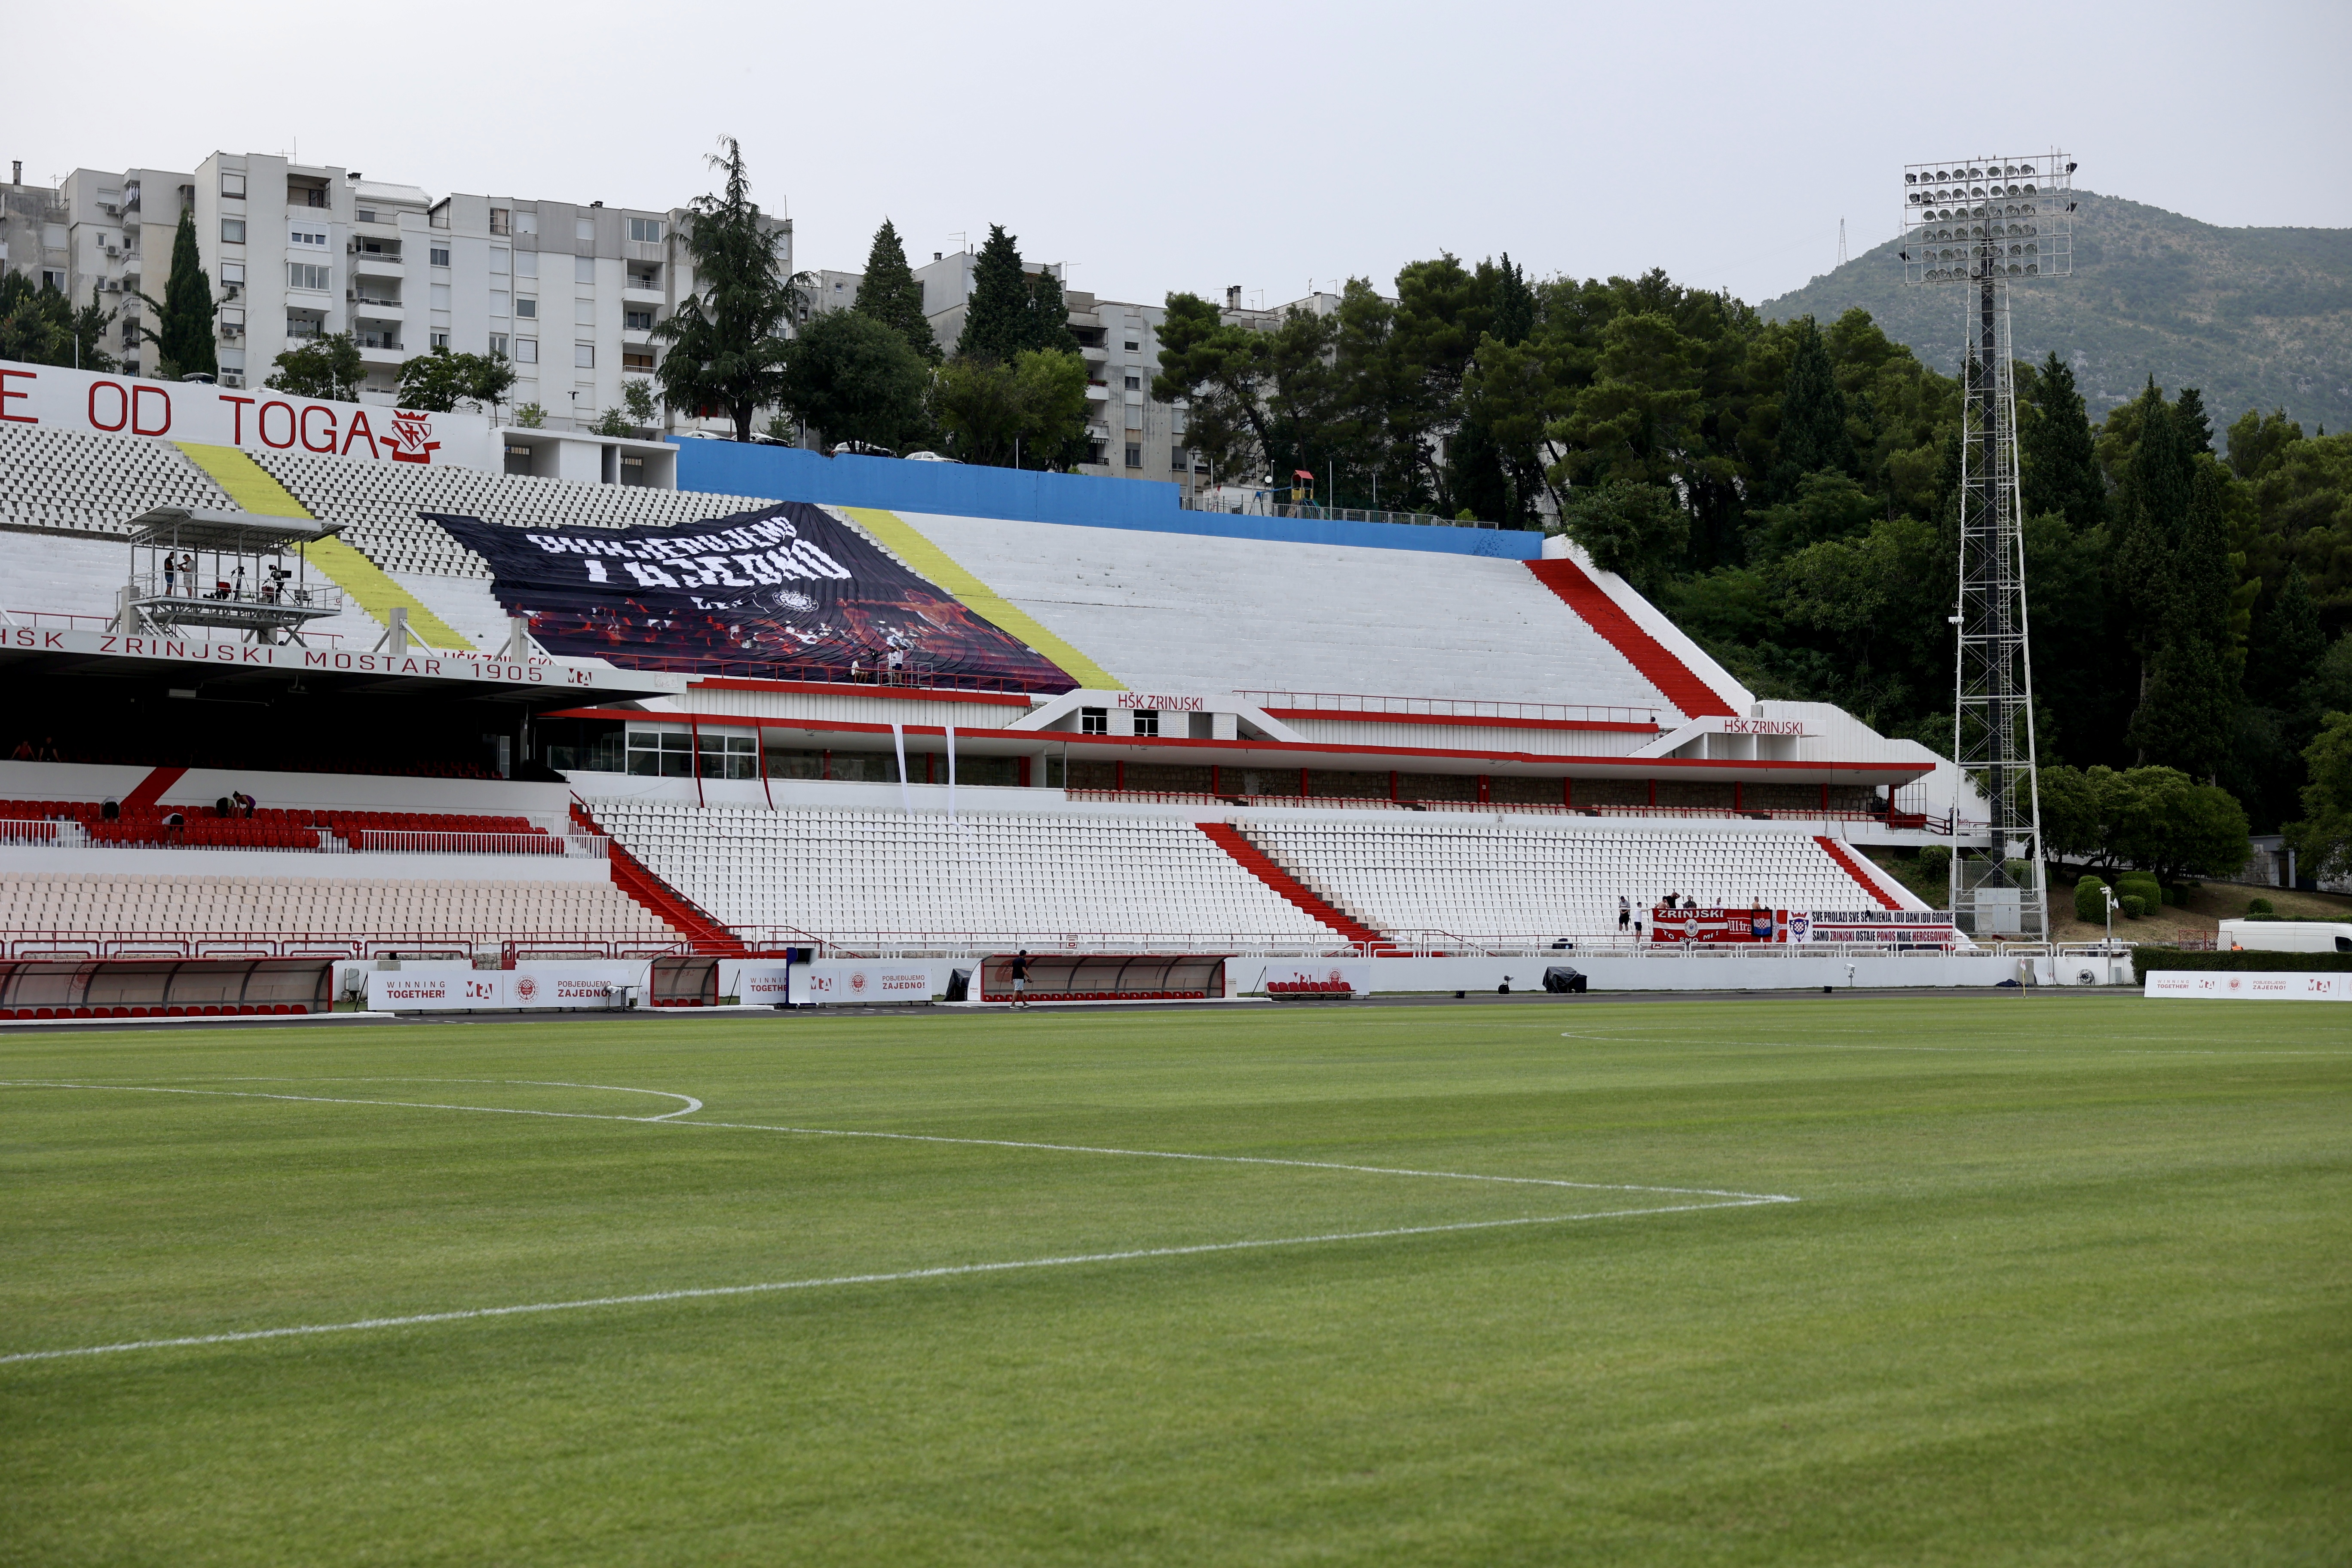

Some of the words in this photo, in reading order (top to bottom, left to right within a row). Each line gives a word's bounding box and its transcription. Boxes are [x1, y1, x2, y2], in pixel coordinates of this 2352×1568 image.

[88, 381, 172, 437] OD
[219, 394, 380, 459] TOGA
[99, 635, 273, 664] ZRINJSKI
[305, 651, 441, 675] MOSTAR
[471, 663, 542, 682] 1905
[1118, 691, 1144, 710] HŠK
[1148, 695, 1203, 711] ZRINJSKI
[1724, 717, 1749, 733] HŠK
[1752, 721, 1803, 735] ZRINJSKI
[1658, 910, 1724, 918] ZRINJSKI
[1812, 911, 1823, 922] SVE
[1824, 912, 1847, 923] PROLAZI
[1849, 912, 1859, 923] SVE
[1869, 912, 1893, 924] MIJENJA,
[1894, 912, 1904, 923] IDU
[1905, 912, 1919, 923] DANI
[1920, 913, 1931, 923] IDU
[1932, 913, 1953, 923] GODINE
[1662, 930, 1675, 940] TO
[1813, 931, 1829, 941] SAMO
[1830, 931, 1854, 942] ZRINJSKI
[1856, 931, 1875, 942] OSTAJE
[1877, 931, 1896, 941] PONOS
[1897, 931, 1911, 942] MOJE
[1913, 931, 1953, 942] HERCEGOVINE!
[352, 941, 363, 951] C
[386, 990, 445, 998] TOGETHER!
[557, 989, 611, 997] ZAJEDNO
